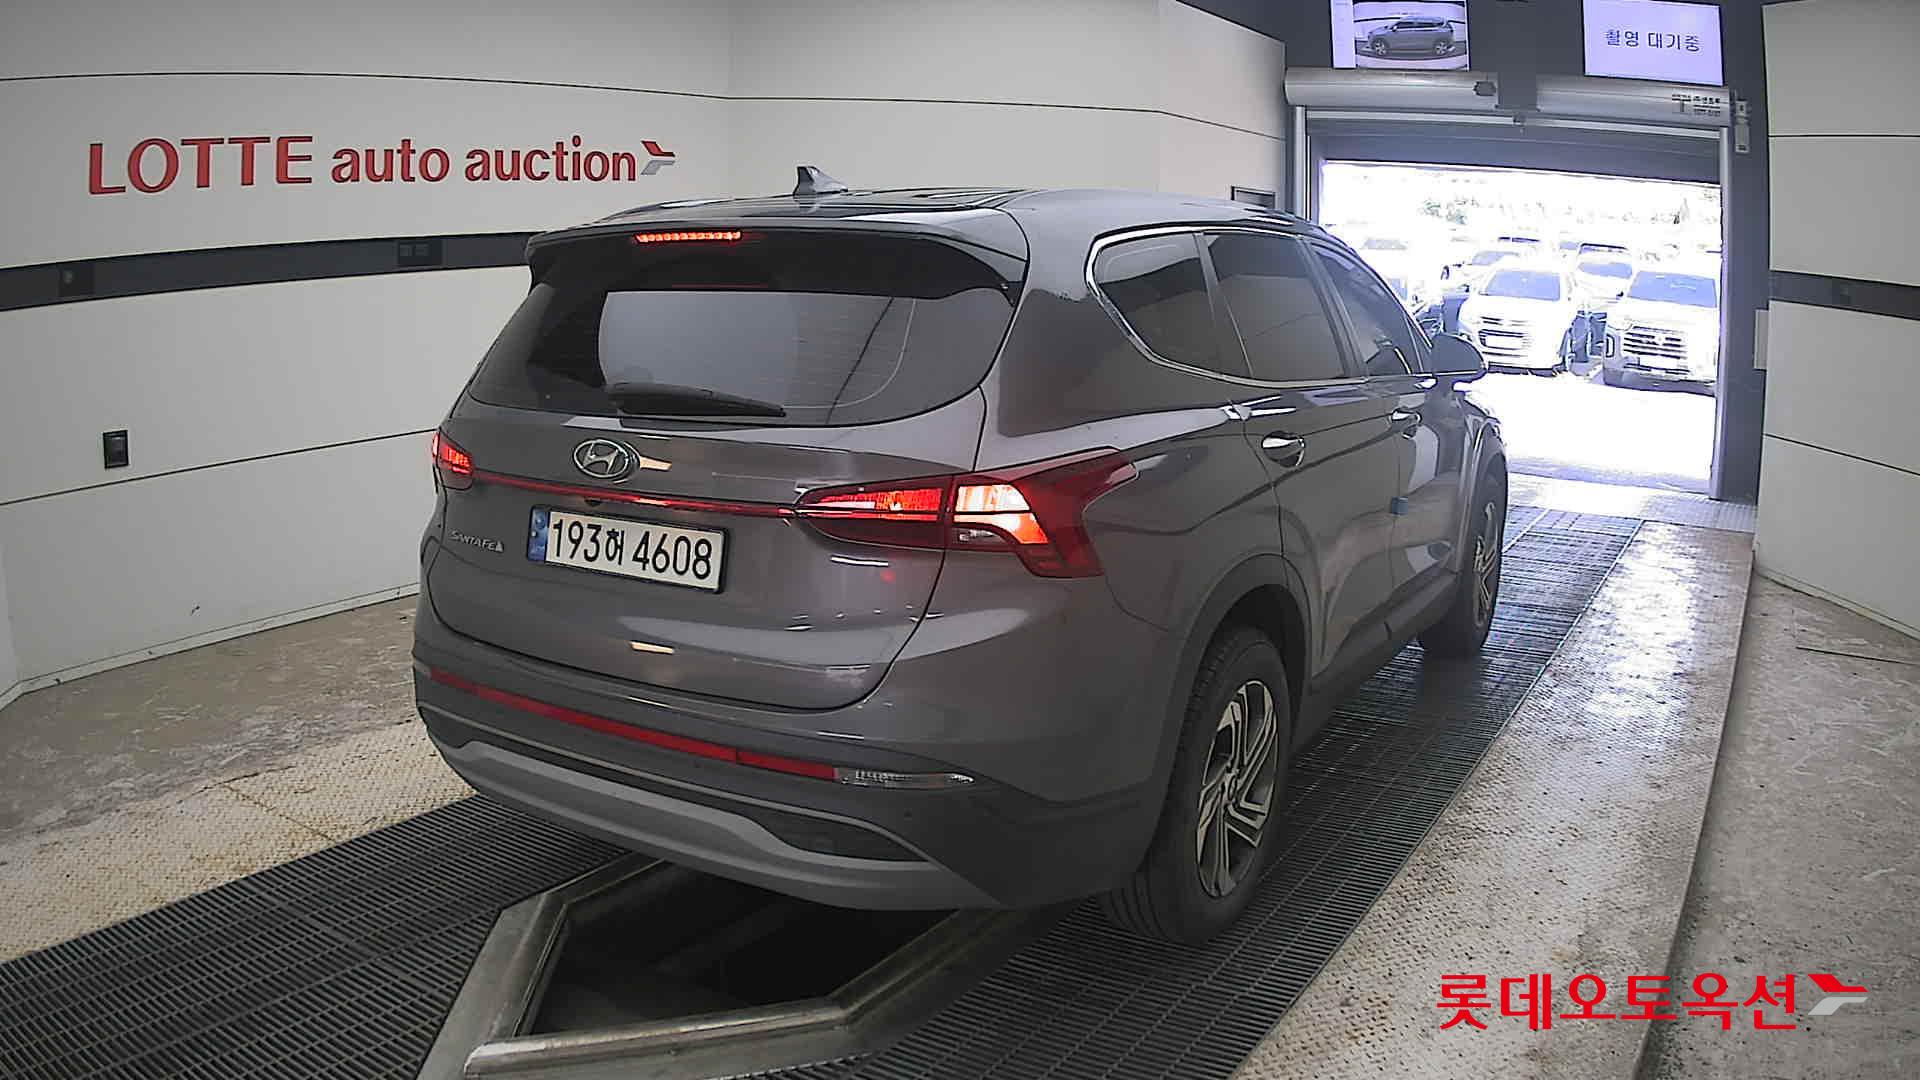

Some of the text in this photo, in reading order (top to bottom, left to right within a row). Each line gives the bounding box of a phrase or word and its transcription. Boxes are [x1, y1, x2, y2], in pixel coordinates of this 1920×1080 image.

[1647, 32, 1700, 52] 대기중
[89, 135, 636, 195] LOTTE auto auction
[552, 518, 713, 581] 193허 4608
